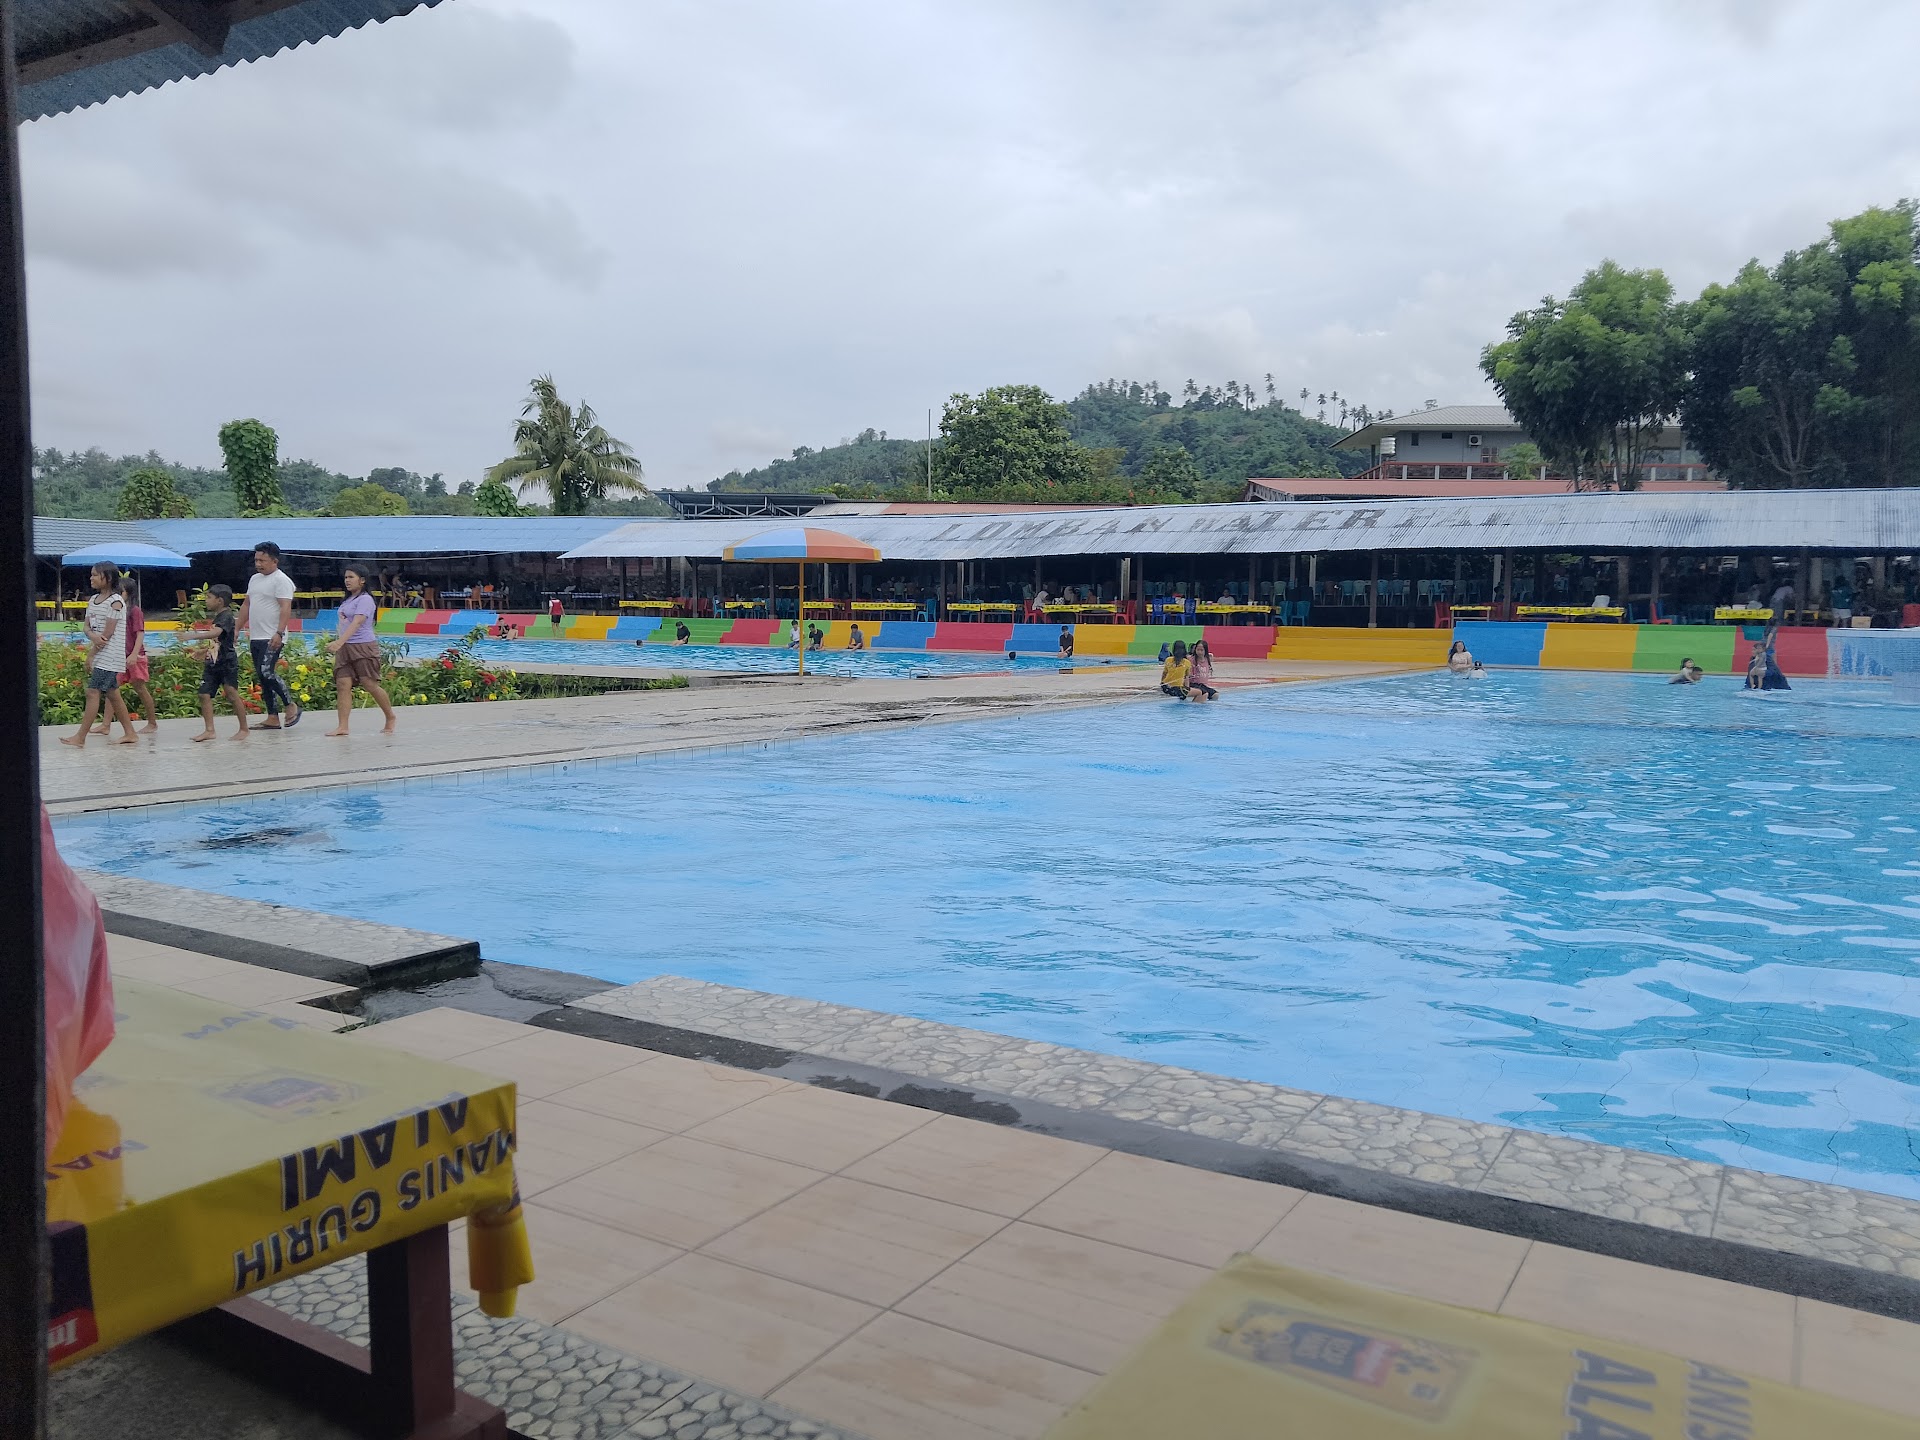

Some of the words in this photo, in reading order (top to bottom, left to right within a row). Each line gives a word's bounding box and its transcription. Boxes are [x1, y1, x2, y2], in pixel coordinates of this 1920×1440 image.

[279, 1092, 469, 1211] ALAMI
[397, 1129, 516, 1212] MANIS
[232, 1189, 382, 1292] GURIH
